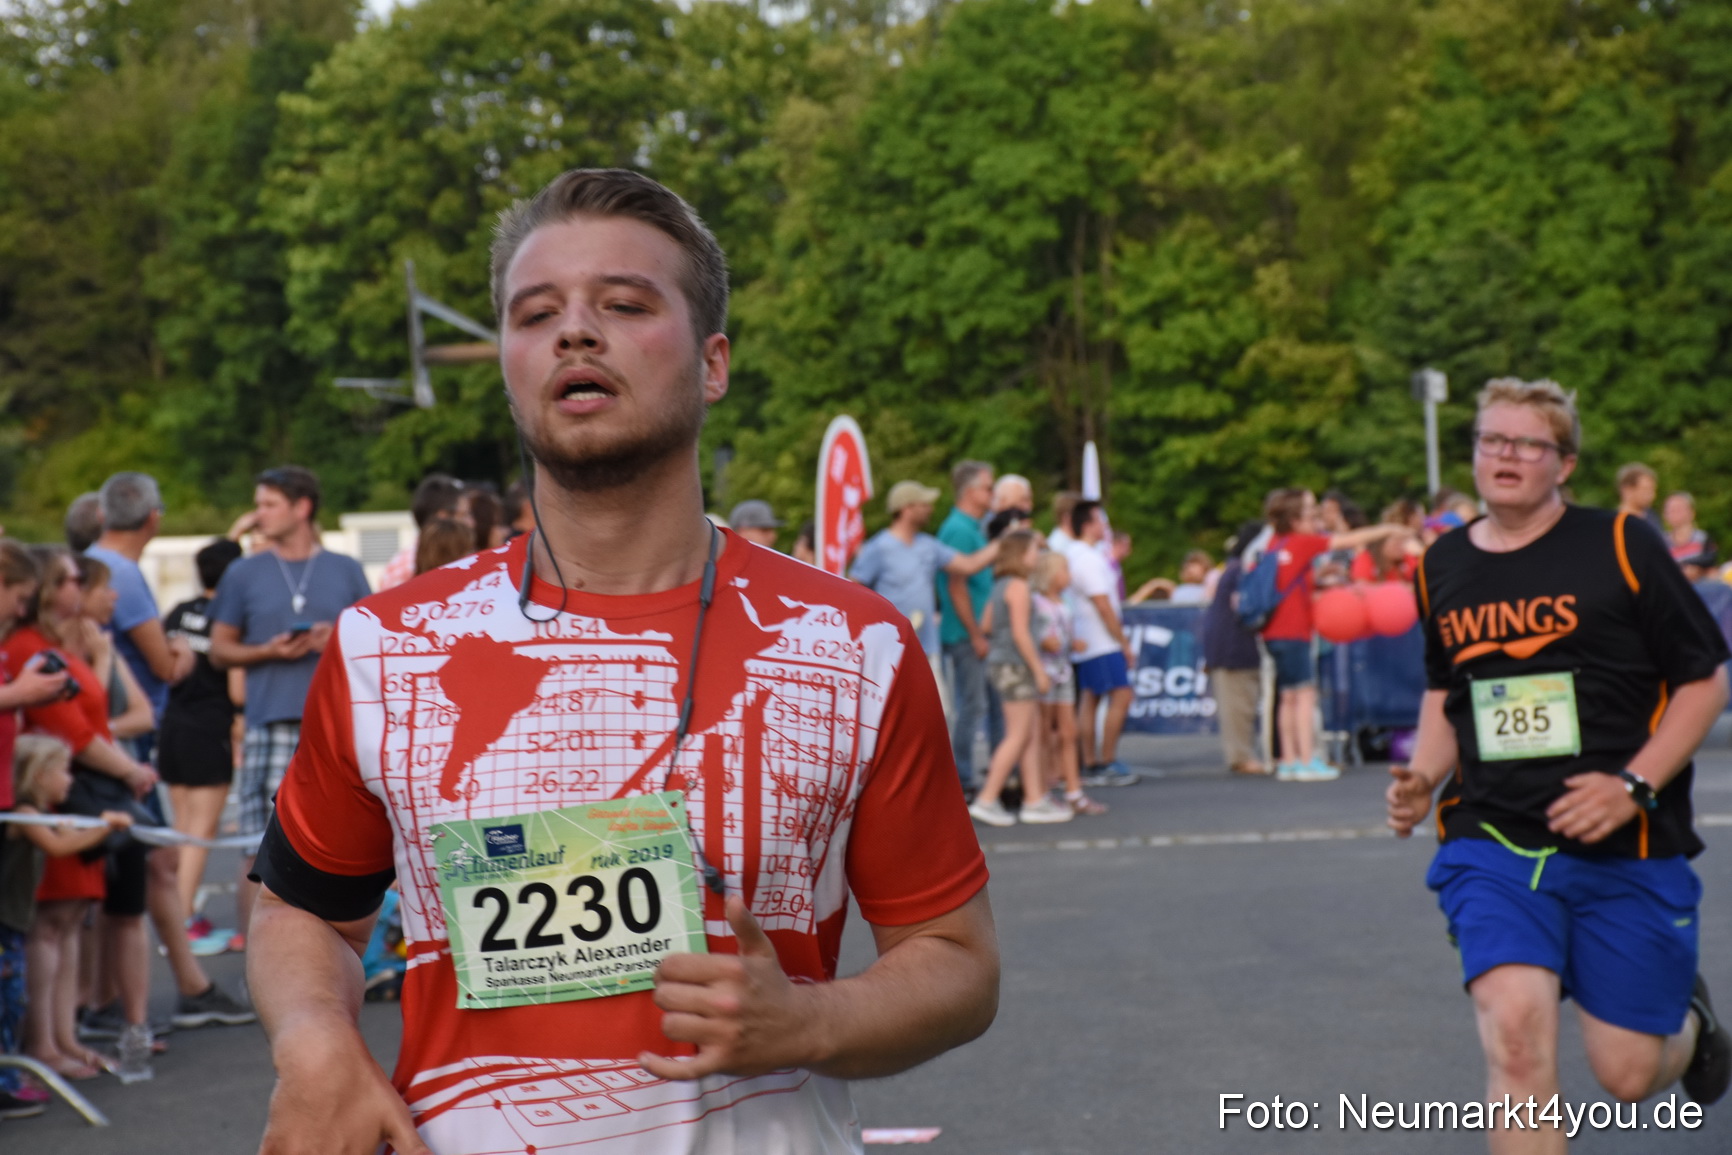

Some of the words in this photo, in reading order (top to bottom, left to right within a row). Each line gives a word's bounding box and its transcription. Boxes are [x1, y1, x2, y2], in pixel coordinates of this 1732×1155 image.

[1450, 594, 1579, 645] WINGS
[775, 635, 864, 665] 91.62%
[1494, 704, 1551, 737] 285
[523, 768, 600, 794] 26.22
[627, 843, 674, 864] 2019
[473, 866, 662, 953] 2230
[484, 951, 569, 973] Talarczyk
[573, 937, 672, 965] Alexander
[486, 973, 546, 989] Sparkasse
